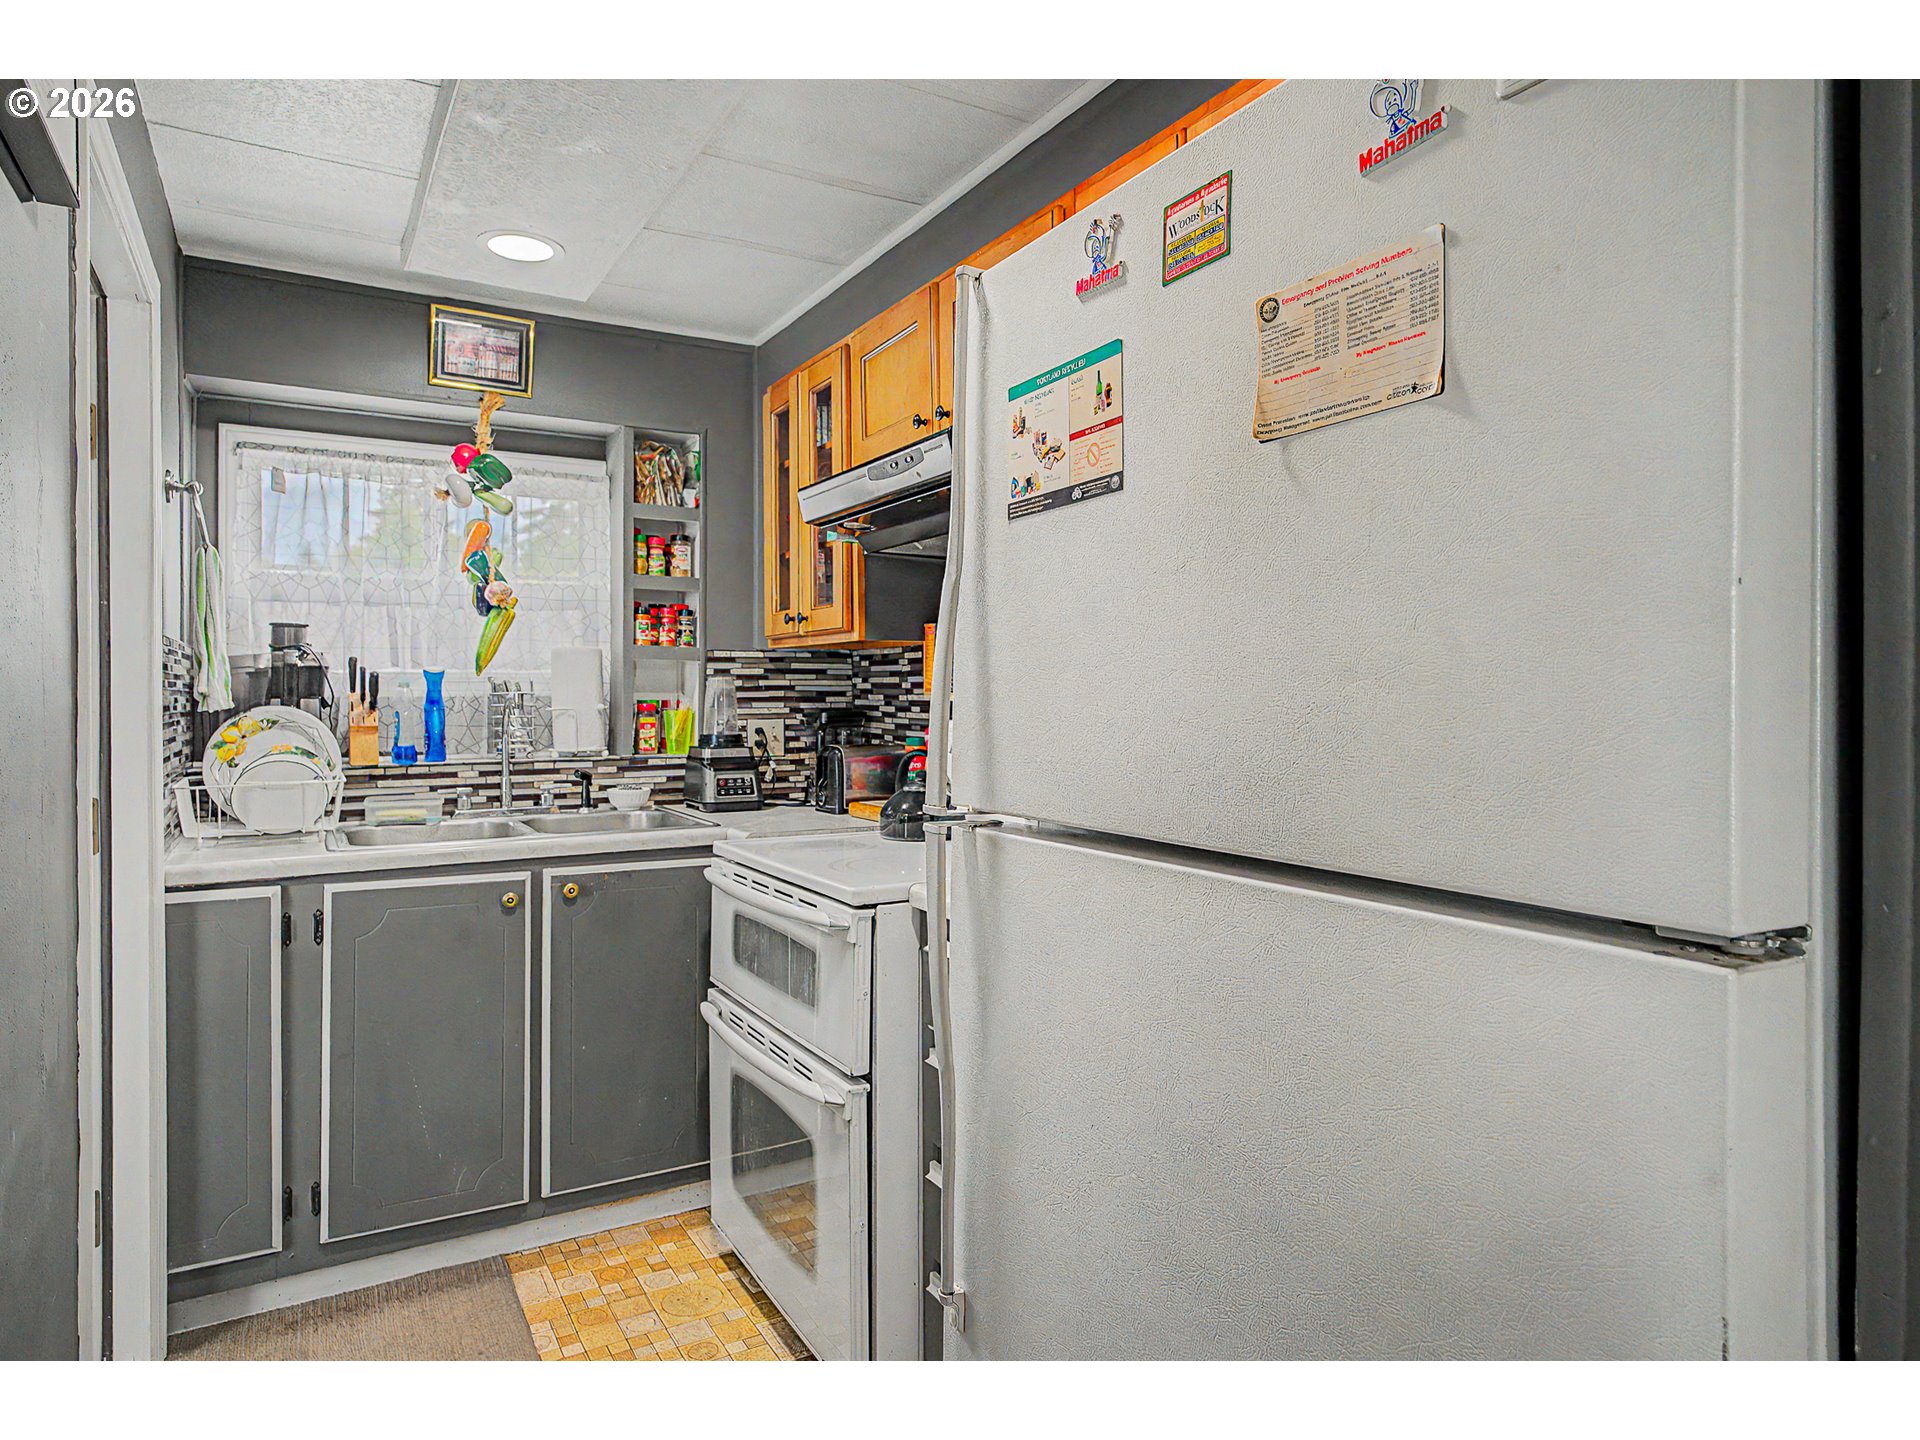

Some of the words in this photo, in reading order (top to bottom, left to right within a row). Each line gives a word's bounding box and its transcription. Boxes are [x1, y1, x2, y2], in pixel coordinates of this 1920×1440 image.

[1359, 111, 1442, 174] Mahatma
[1075, 263, 1119, 296] Mahatma
[1281, 287, 1315, 305] Emergency
[1315, 281, 1327, 291] and
